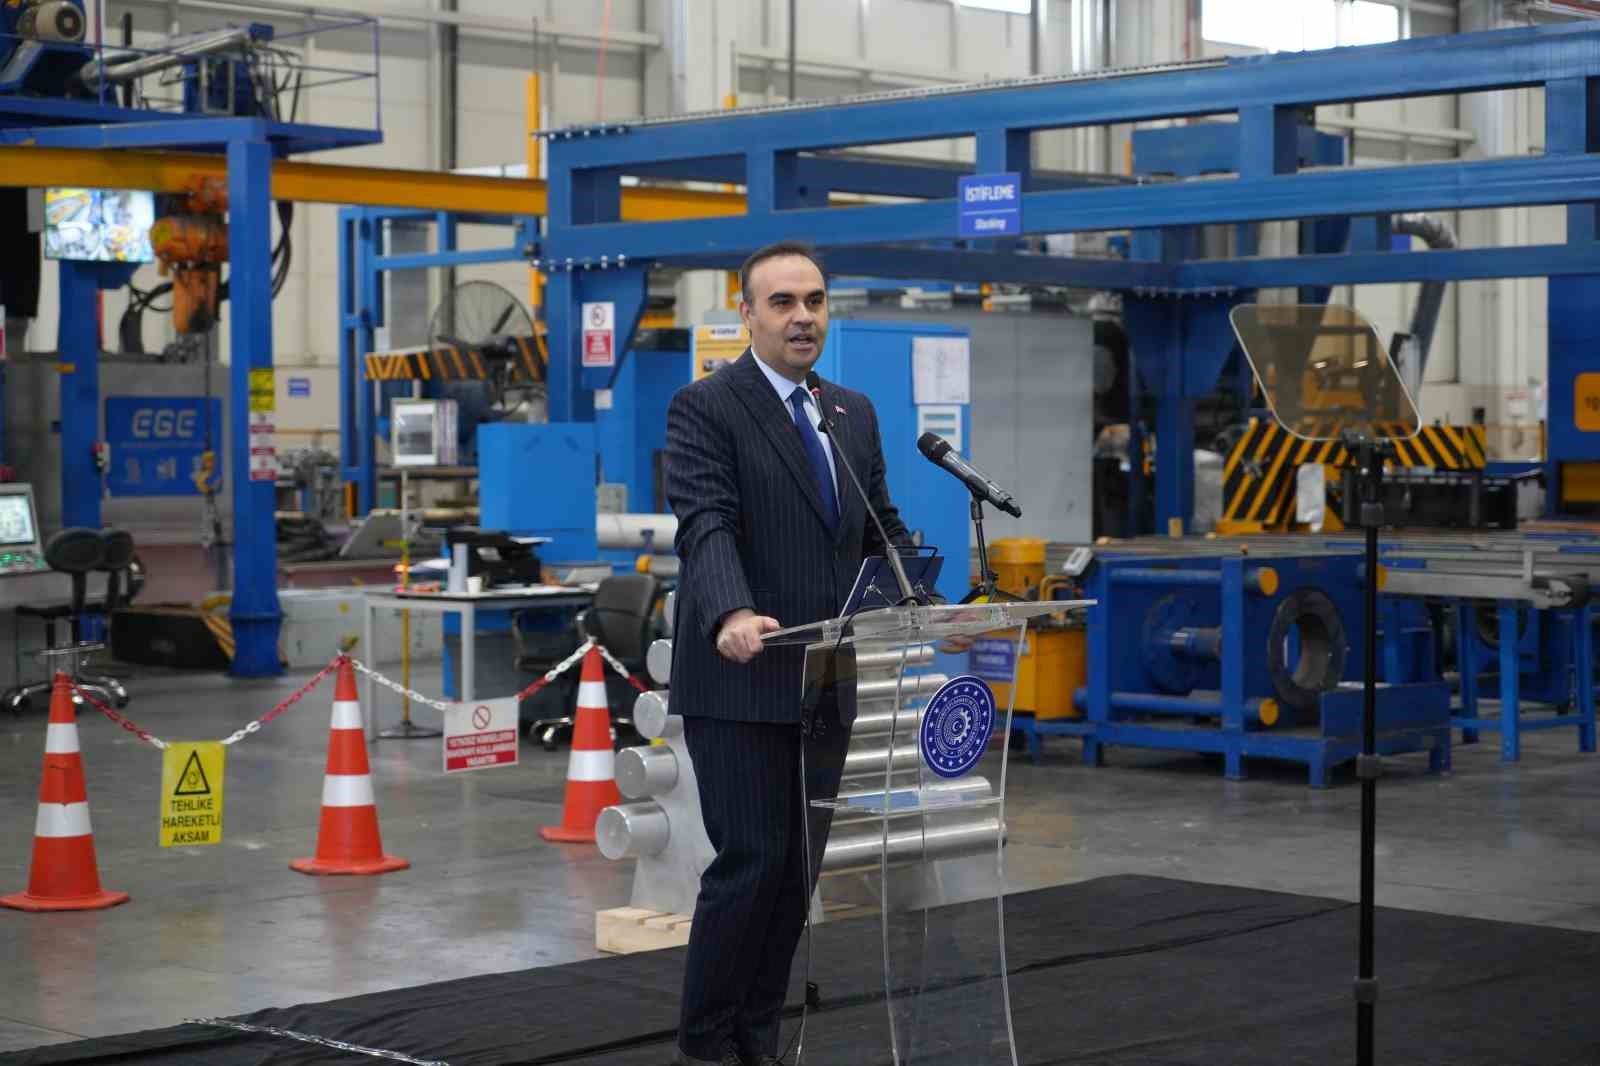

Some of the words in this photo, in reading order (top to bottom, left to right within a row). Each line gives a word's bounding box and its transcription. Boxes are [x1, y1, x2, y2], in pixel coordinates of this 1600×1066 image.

[133, 408, 197, 437] EGE
[172, 797, 213, 812] TEHLİKE
[162, 813, 220, 828] HAREKETLİ
[172, 830, 210, 843] AKSAM
